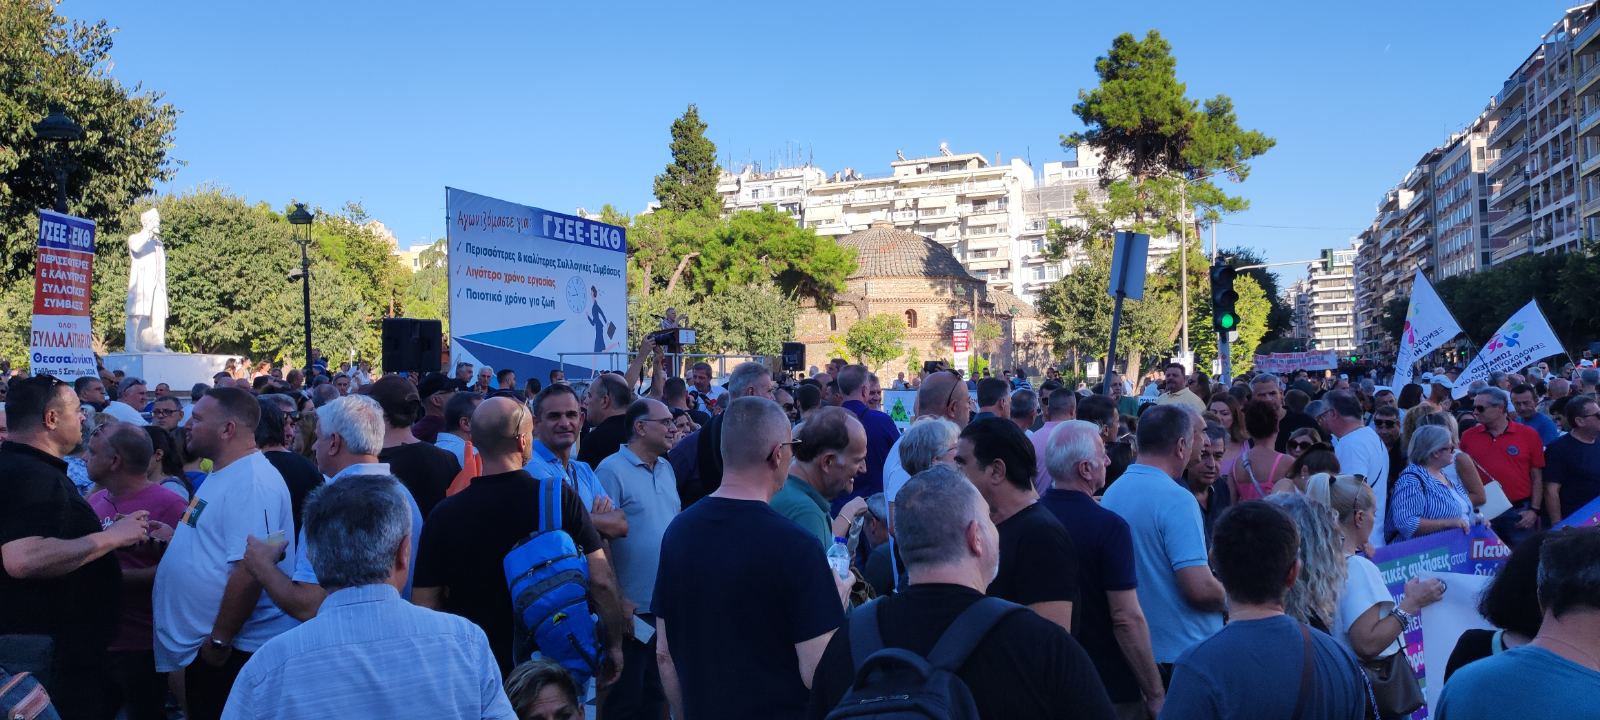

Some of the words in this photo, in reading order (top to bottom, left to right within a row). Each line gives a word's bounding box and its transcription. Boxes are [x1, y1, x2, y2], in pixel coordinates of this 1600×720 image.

[457, 209, 515, 232] Αγωνιζόμαστε
[543, 214, 621, 250] ΓΣΕΕ-ΕΚΘ
[465, 242, 516, 263] Περισσότερες
[518, 252, 523, 262] &
[523, 253, 557, 270] καλύτερες
[557, 258, 592, 274] Συλλογικές
[593, 263, 621, 279] Συμβάσεις
[465, 266, 502, 282] Λιγότερο
[504, 271, 525, 284] χρόνο
[527, 275, 557, 289] εργασίας
[466, 288, 502, 302] Ποιοτικό
[504, 292, 527, 306] χρόνο
[529, 296, 540, 308] για
[541, 296, 556, 310] ζωή
[1381, 561, 1408, 584] τικές
